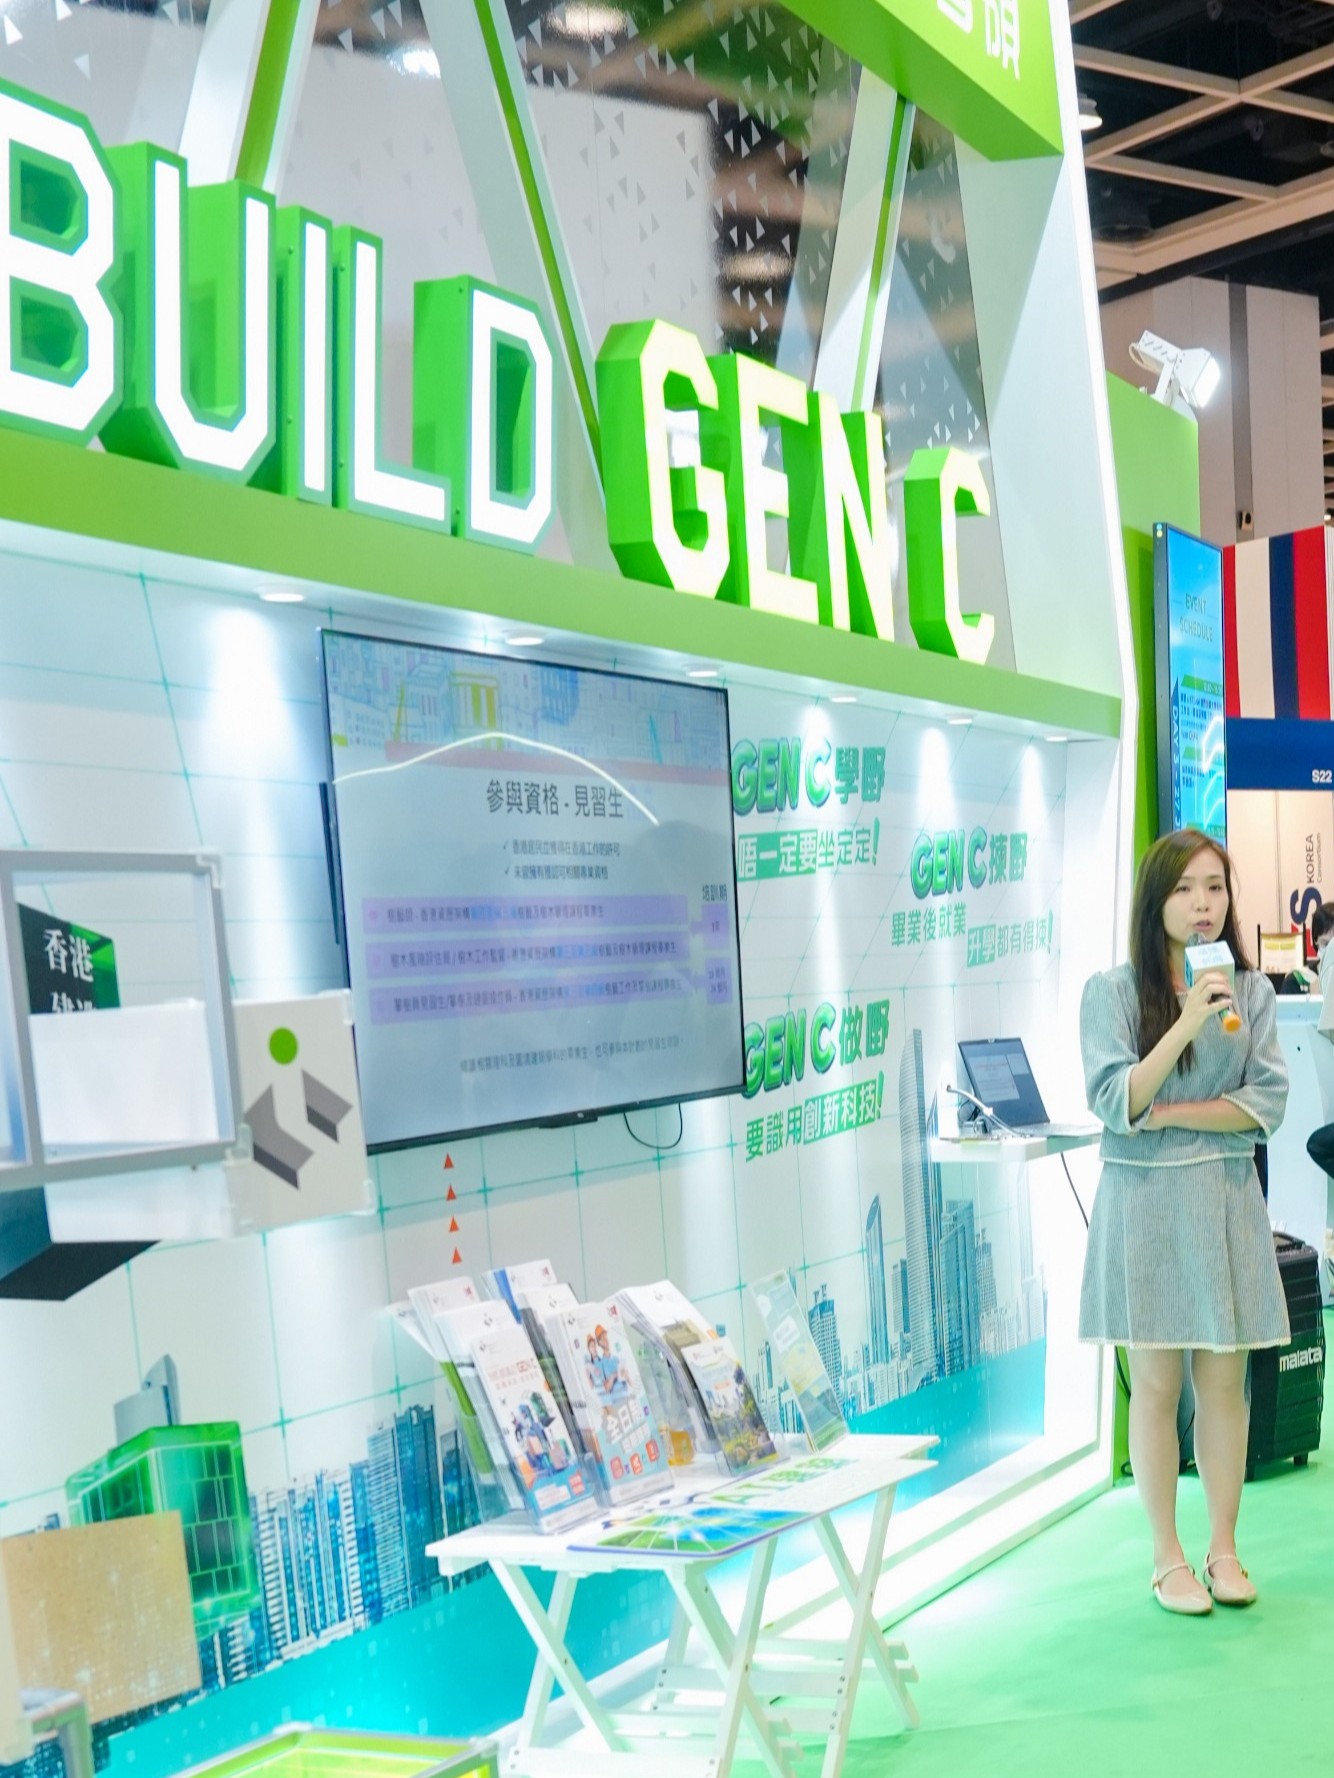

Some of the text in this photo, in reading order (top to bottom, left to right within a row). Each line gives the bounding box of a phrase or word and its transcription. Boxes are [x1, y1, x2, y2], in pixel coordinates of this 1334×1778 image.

[0, 82, 995, 664] BUILD GEN C
[1179, 616, 1213, 642] SCHEDULE
[1185, 593, 1207, 616] EVENT
[486, 779, 560, 815] 參與資格
[574, 784, 624, 819] 見習生
[731, 737, 801, 816] GEN
[804, 737, 832, 808] C
[1312, 770, 1333, 783] S22
[911, 829, 964, 899] GEN
[967, 826, 987, 889] C
[1305, 833, 1315, 884] KOREA
[1315, 832, 1323, 883] Consortium
[43, 928, 95, 982] 香港
[742, 1007, 807, 1099] GEN
[811, 1002, 836, 1074] C
[1279, 1346, 1323, 1372] malata
